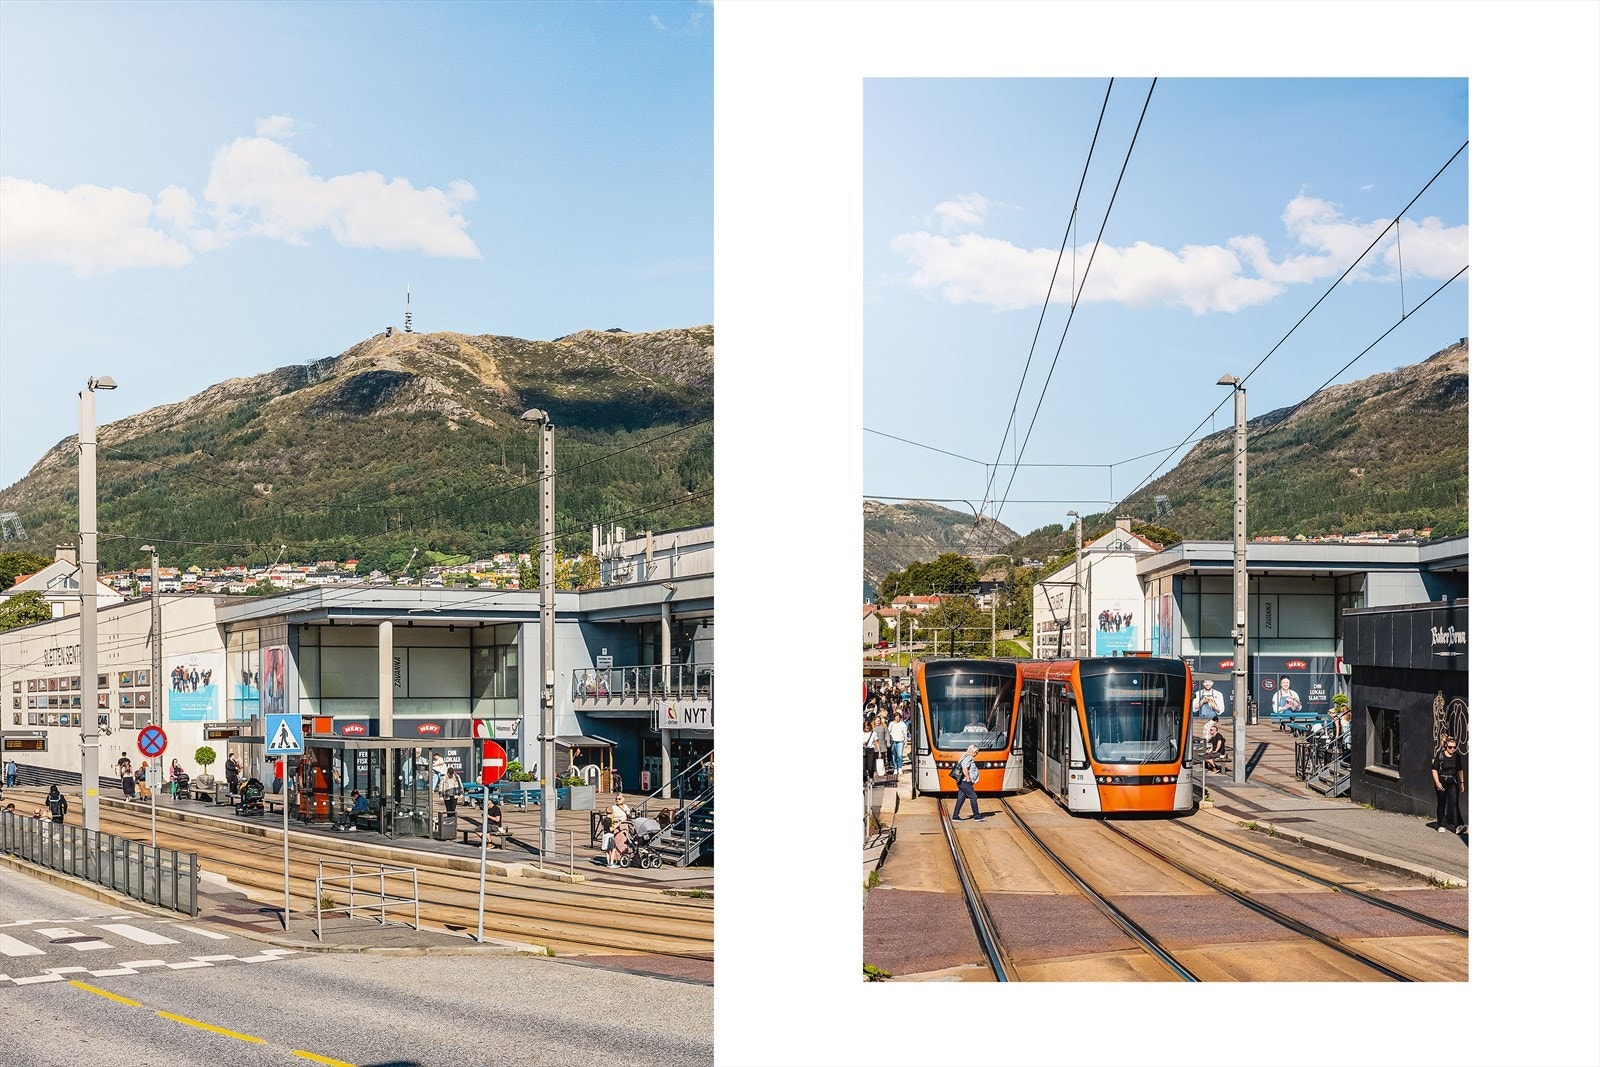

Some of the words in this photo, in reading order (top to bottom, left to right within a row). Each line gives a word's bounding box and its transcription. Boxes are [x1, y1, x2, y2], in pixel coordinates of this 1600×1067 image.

[685, 708, 707, 723] NYT
[344, 724, 364, 733] MENY
[419, 724, 438, 733] MENY
